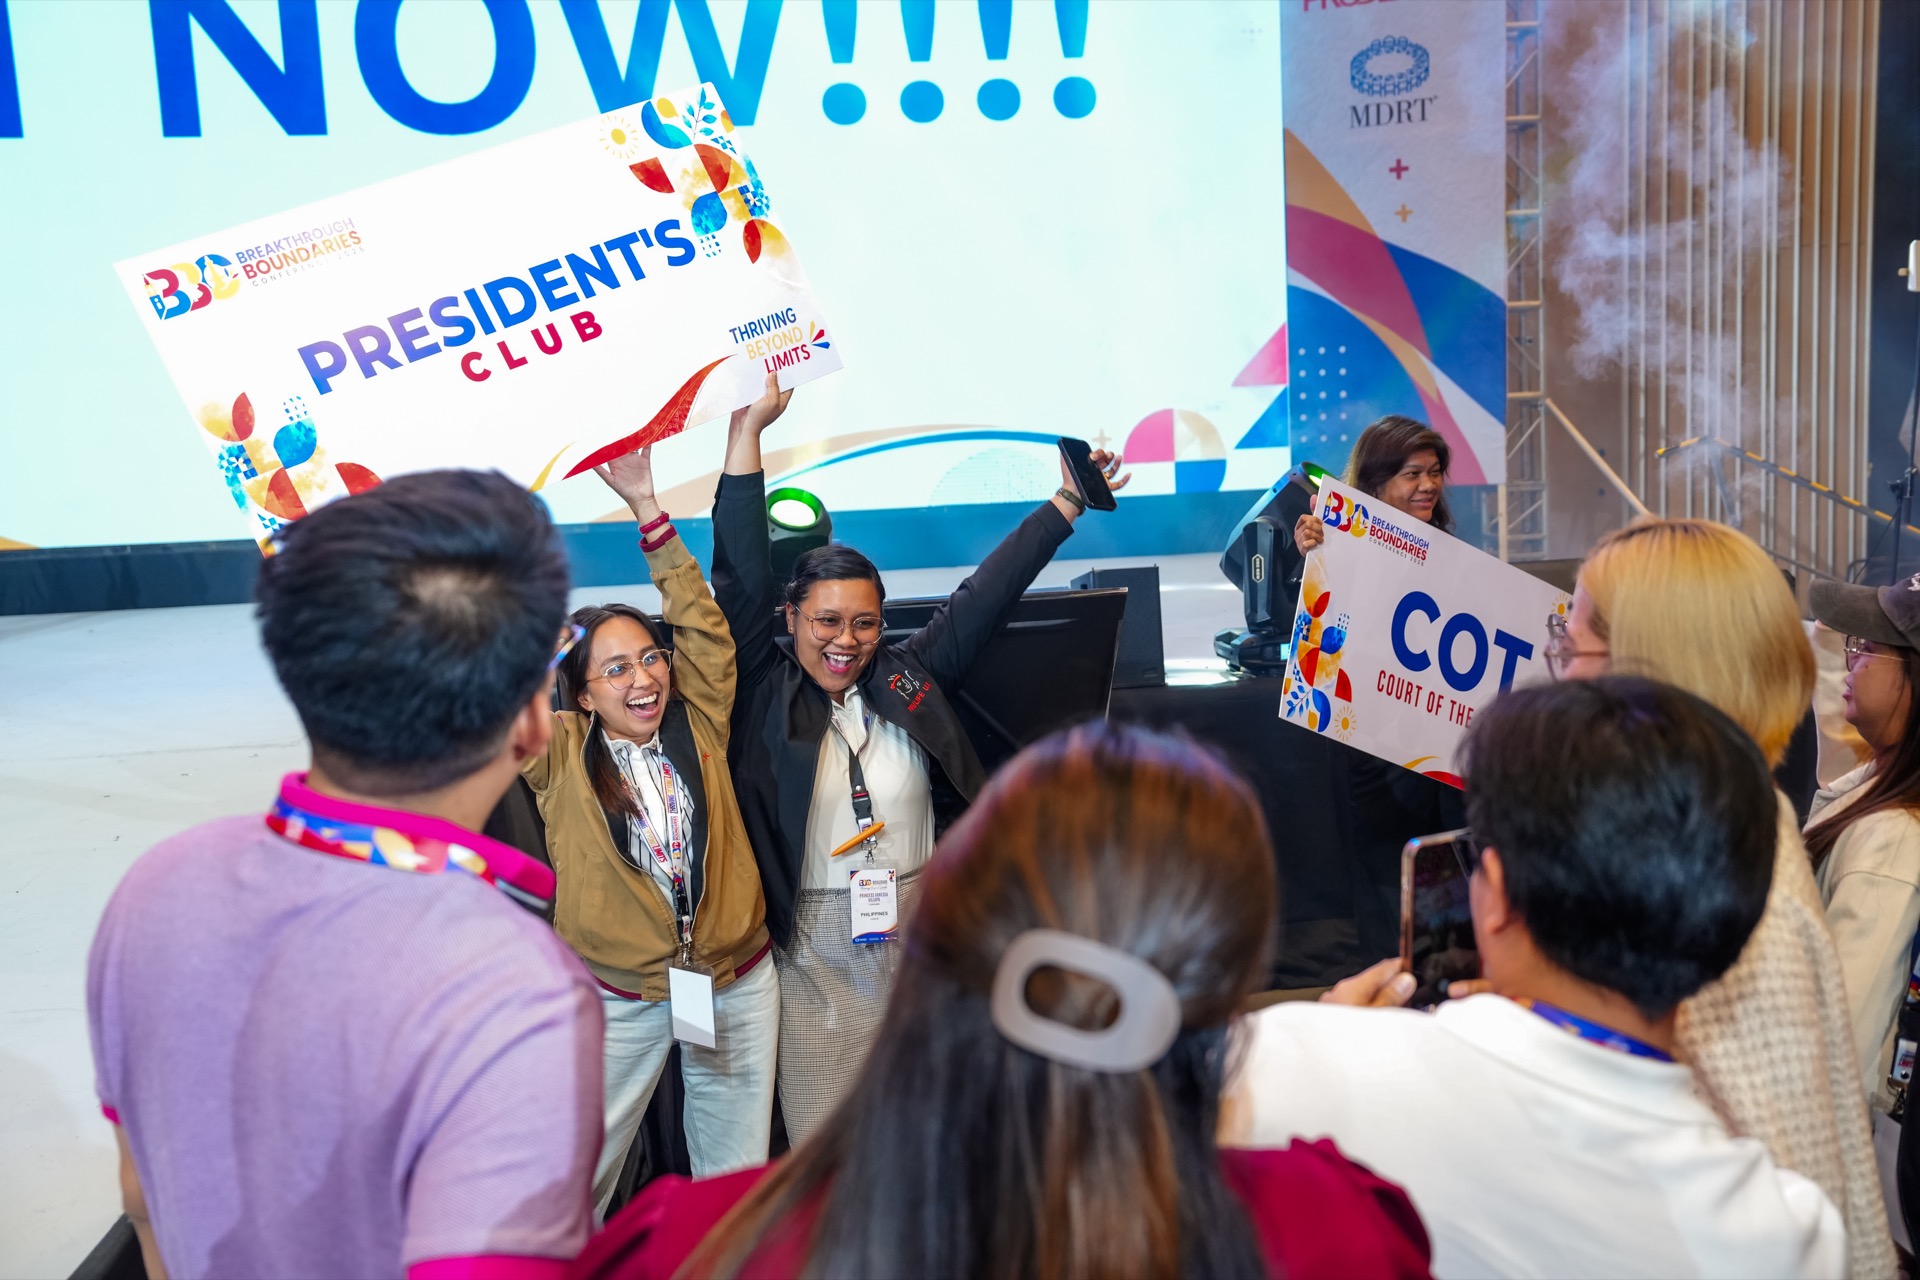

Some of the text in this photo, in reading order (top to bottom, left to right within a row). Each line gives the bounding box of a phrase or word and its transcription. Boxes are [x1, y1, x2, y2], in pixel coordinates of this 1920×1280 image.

[148, 0, 1097, 137] NOW!!!!
[235, 217, 356, 264] BREAKTHROUGH
[242, 230, 362, 279] BOUNDARIES
[297, 219, 696, 396] PRESIDENT'S
[728, 307, 797, 344] THRIVING
[461, 310, 603, 382] CLUB
[745, 326, 803, 360] BEYOND
[764, 344, 811, 374] LIMITS
[1369, 525, 1428, 561] BOUNDARIES
[1371, 515, 1430, 550] BREAKTHROUGH
[1391, 590, 1534, 698] COT
[1377, 669, 1475, 729] COURT OF THE
